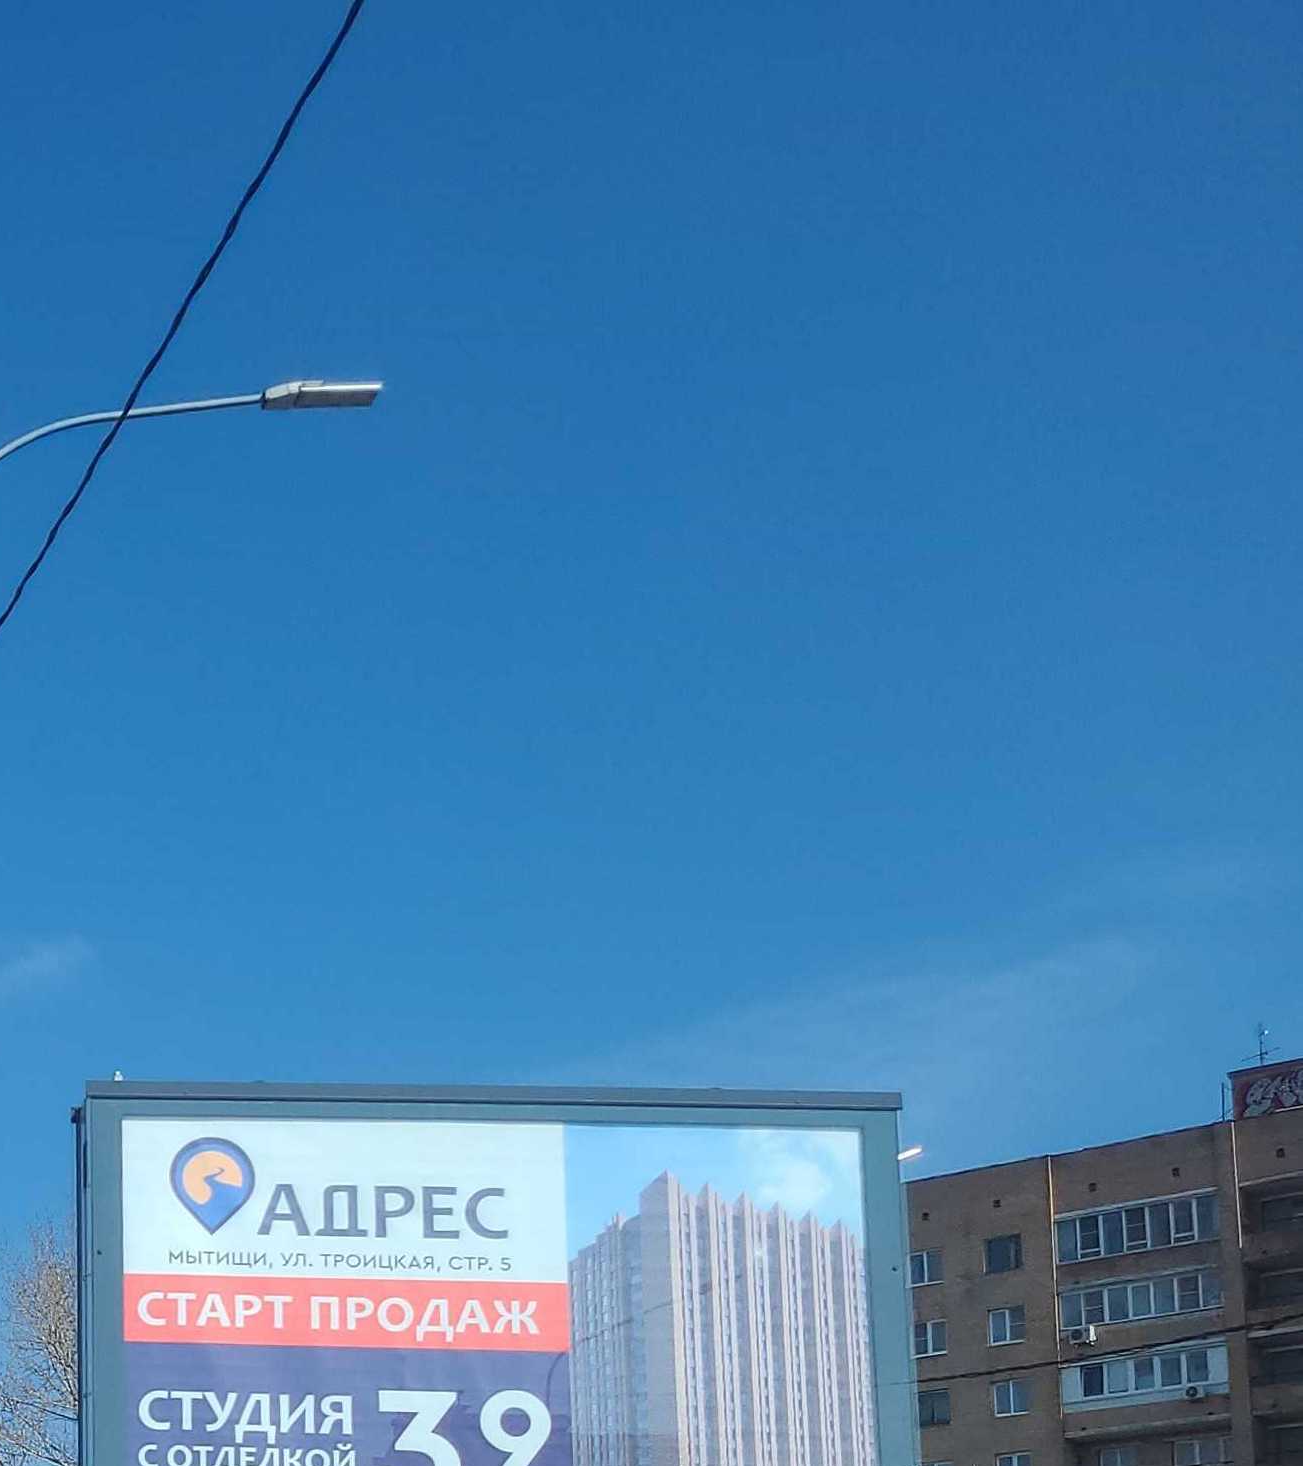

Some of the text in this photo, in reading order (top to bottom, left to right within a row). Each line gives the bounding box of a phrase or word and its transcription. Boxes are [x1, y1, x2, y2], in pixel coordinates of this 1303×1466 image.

[256, 1183, 510, 1240] АДРЕС
[168, 1250, 512, 1273] МЫТИЩИ, УЛ. ТРОИЦКАЯ, СТР. 5
[137, 1291, 540, 1343] СТАРТ ПРОДАЖ
[137, 1390, 354, 1444] СТУДИЯ
